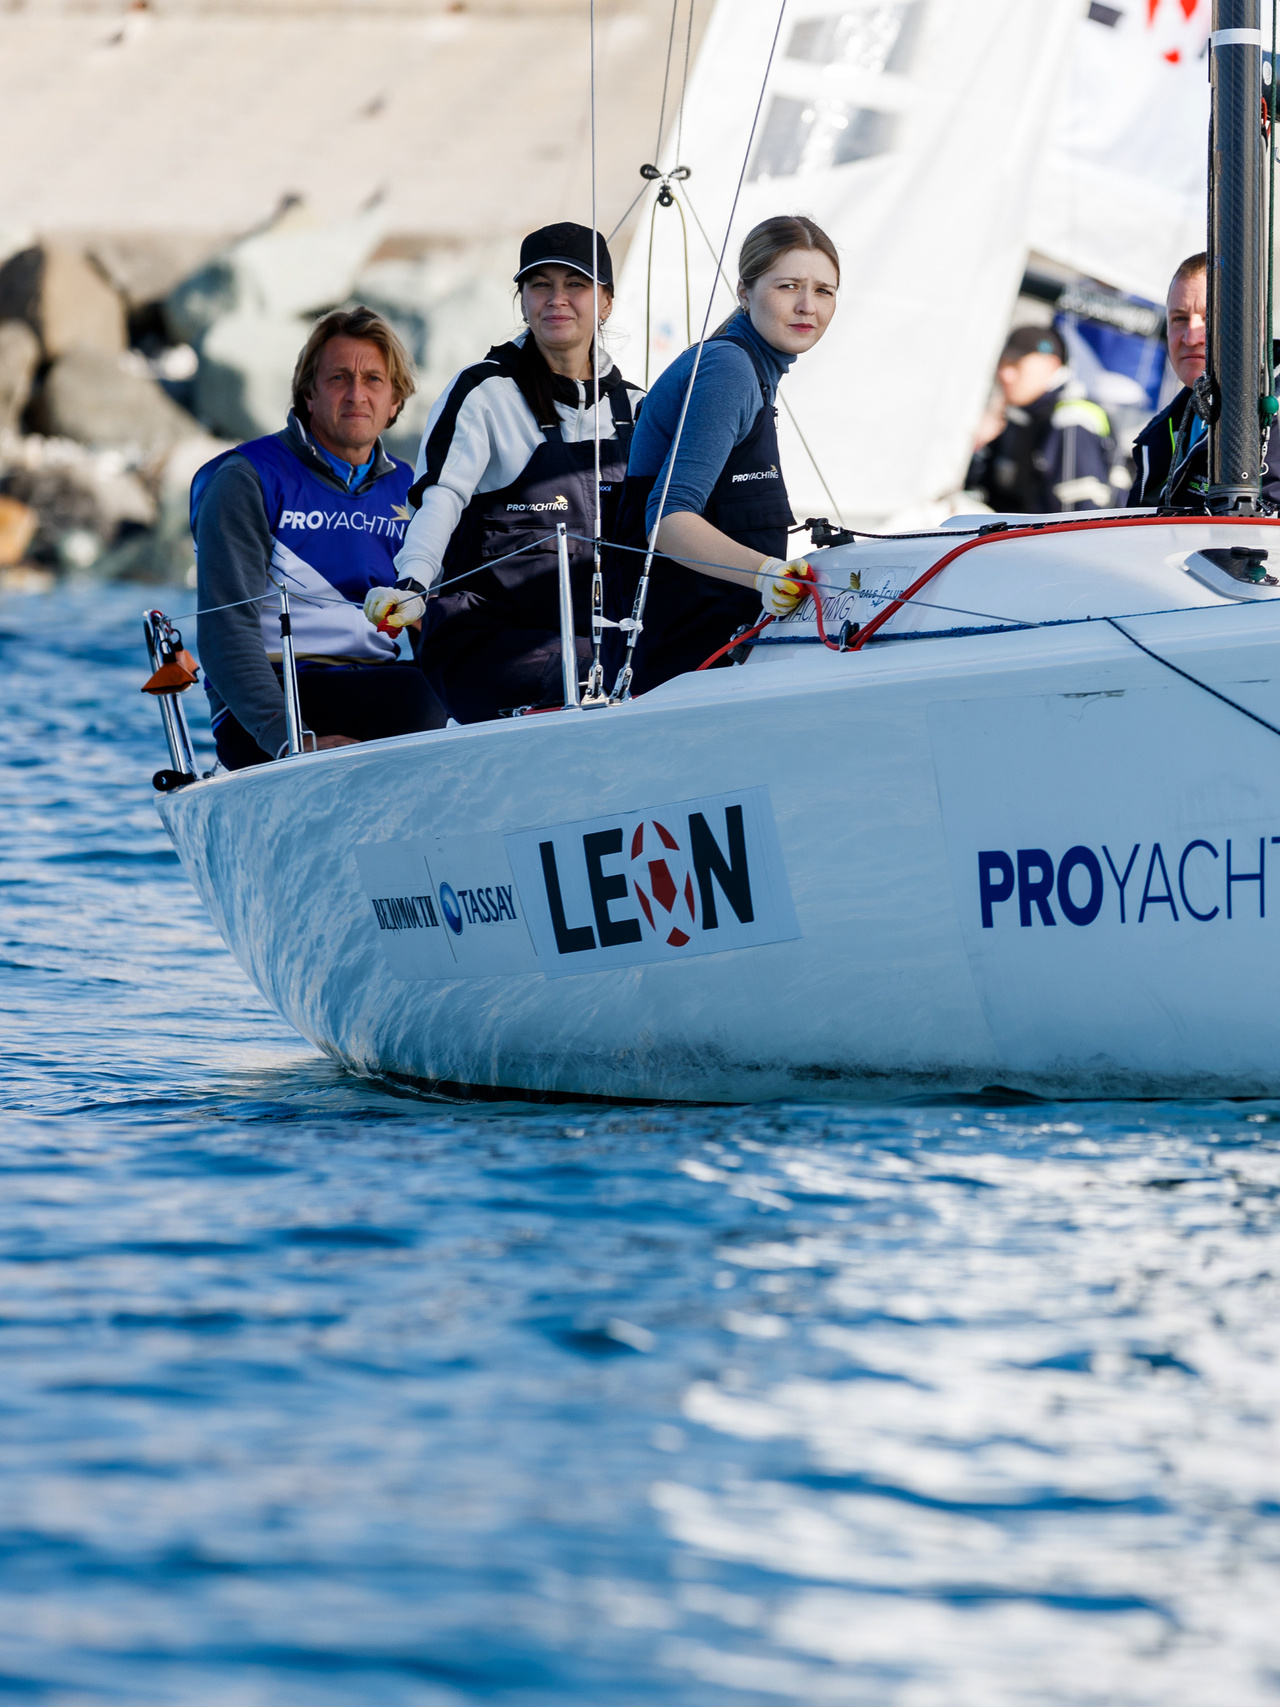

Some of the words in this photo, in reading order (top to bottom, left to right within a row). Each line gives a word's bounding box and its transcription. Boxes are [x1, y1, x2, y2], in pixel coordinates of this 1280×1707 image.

[731, 470, 779, 483] PROYACHTING
[506, 502, 568, 511] PROYACHTING
[278, 510, 405, 540] PROYACHTIN
[760, 596, 855, 622] ACHTING
[539, 804, 755, 955] LEON
[371, 895, 440, 936] ВЕДОМОСТИ
[457, 885, 518, 924] TASSAY
